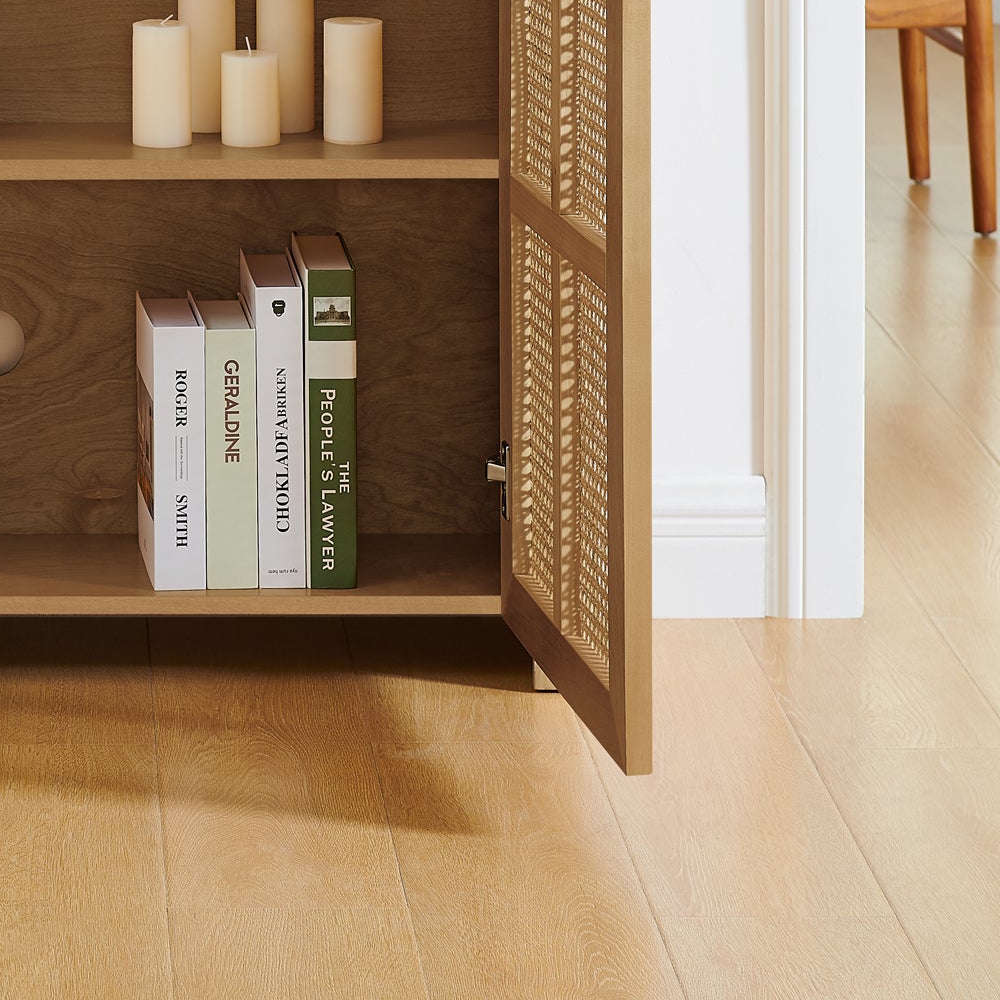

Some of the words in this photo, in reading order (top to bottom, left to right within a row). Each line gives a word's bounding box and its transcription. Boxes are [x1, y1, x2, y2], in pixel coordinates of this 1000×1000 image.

[175, 369, 188, 427] ROGER
[223, 359, 240, 463] GERALDINE
[320, 389, 336, 482] PEOPLE'S
[275, 367, 290, 533] CHOKLADFABRIKEN
[339, 461, 350, 493] THE
[175, 494, 188, 547] SMITH
[321, 489, 336, 570] LAWYER
